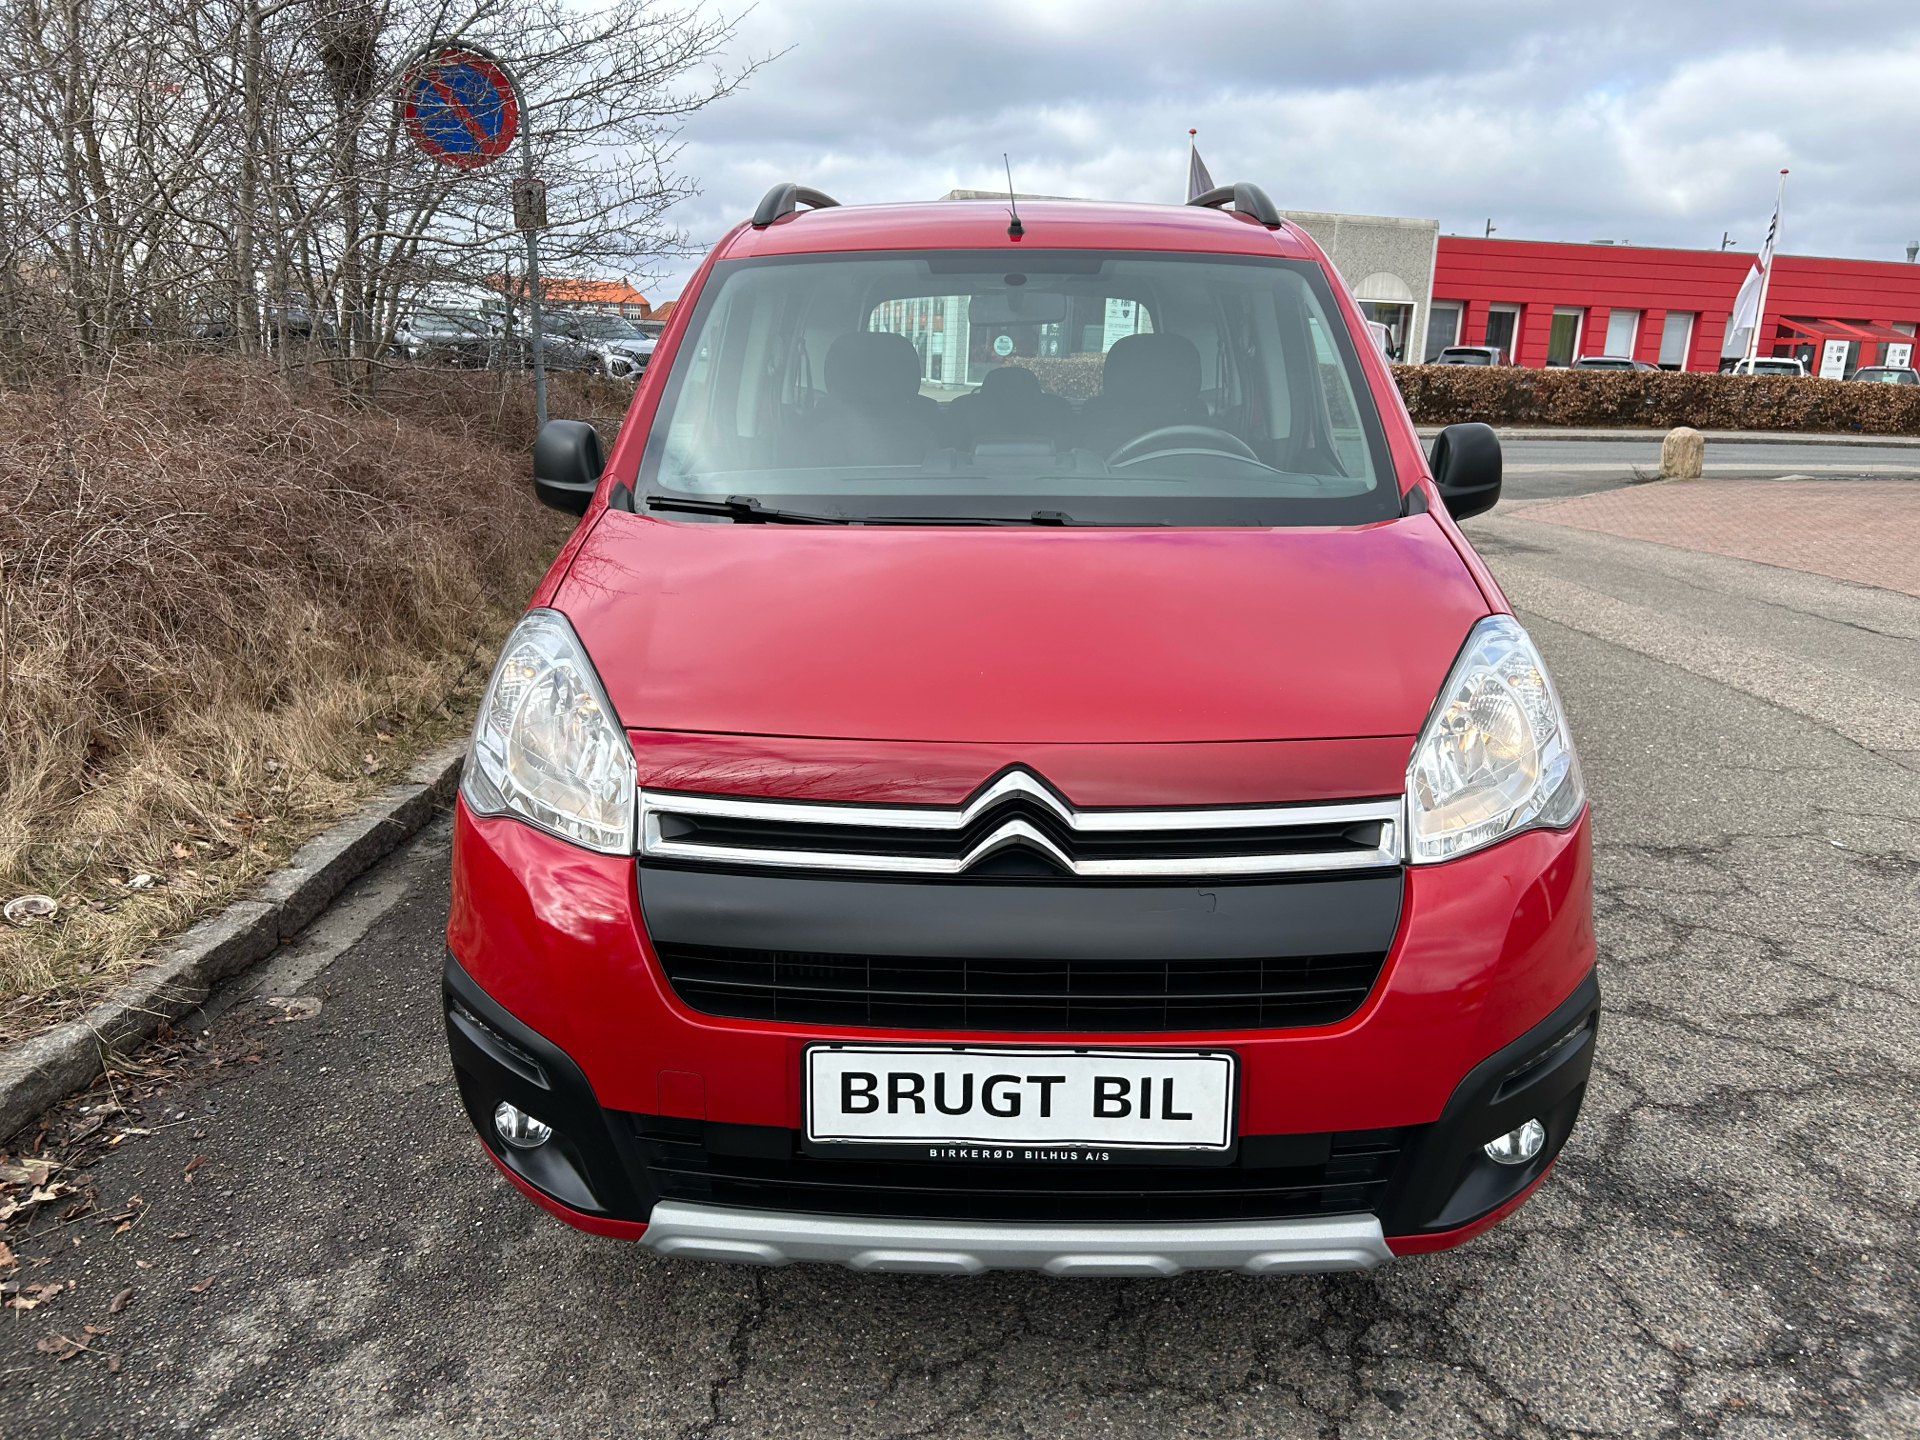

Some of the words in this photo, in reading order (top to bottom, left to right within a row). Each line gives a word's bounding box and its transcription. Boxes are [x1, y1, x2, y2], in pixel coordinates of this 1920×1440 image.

[840, 1071, 1066, 1118] BRUGT
[1093, 1076, 1193, 1121] BIL
[930, 1149, 1014, 1159] BIRKERØD
[1025, 1151, 1078, 1160] BILHUS
[1085, 1152, 1109, 1161] A/S
